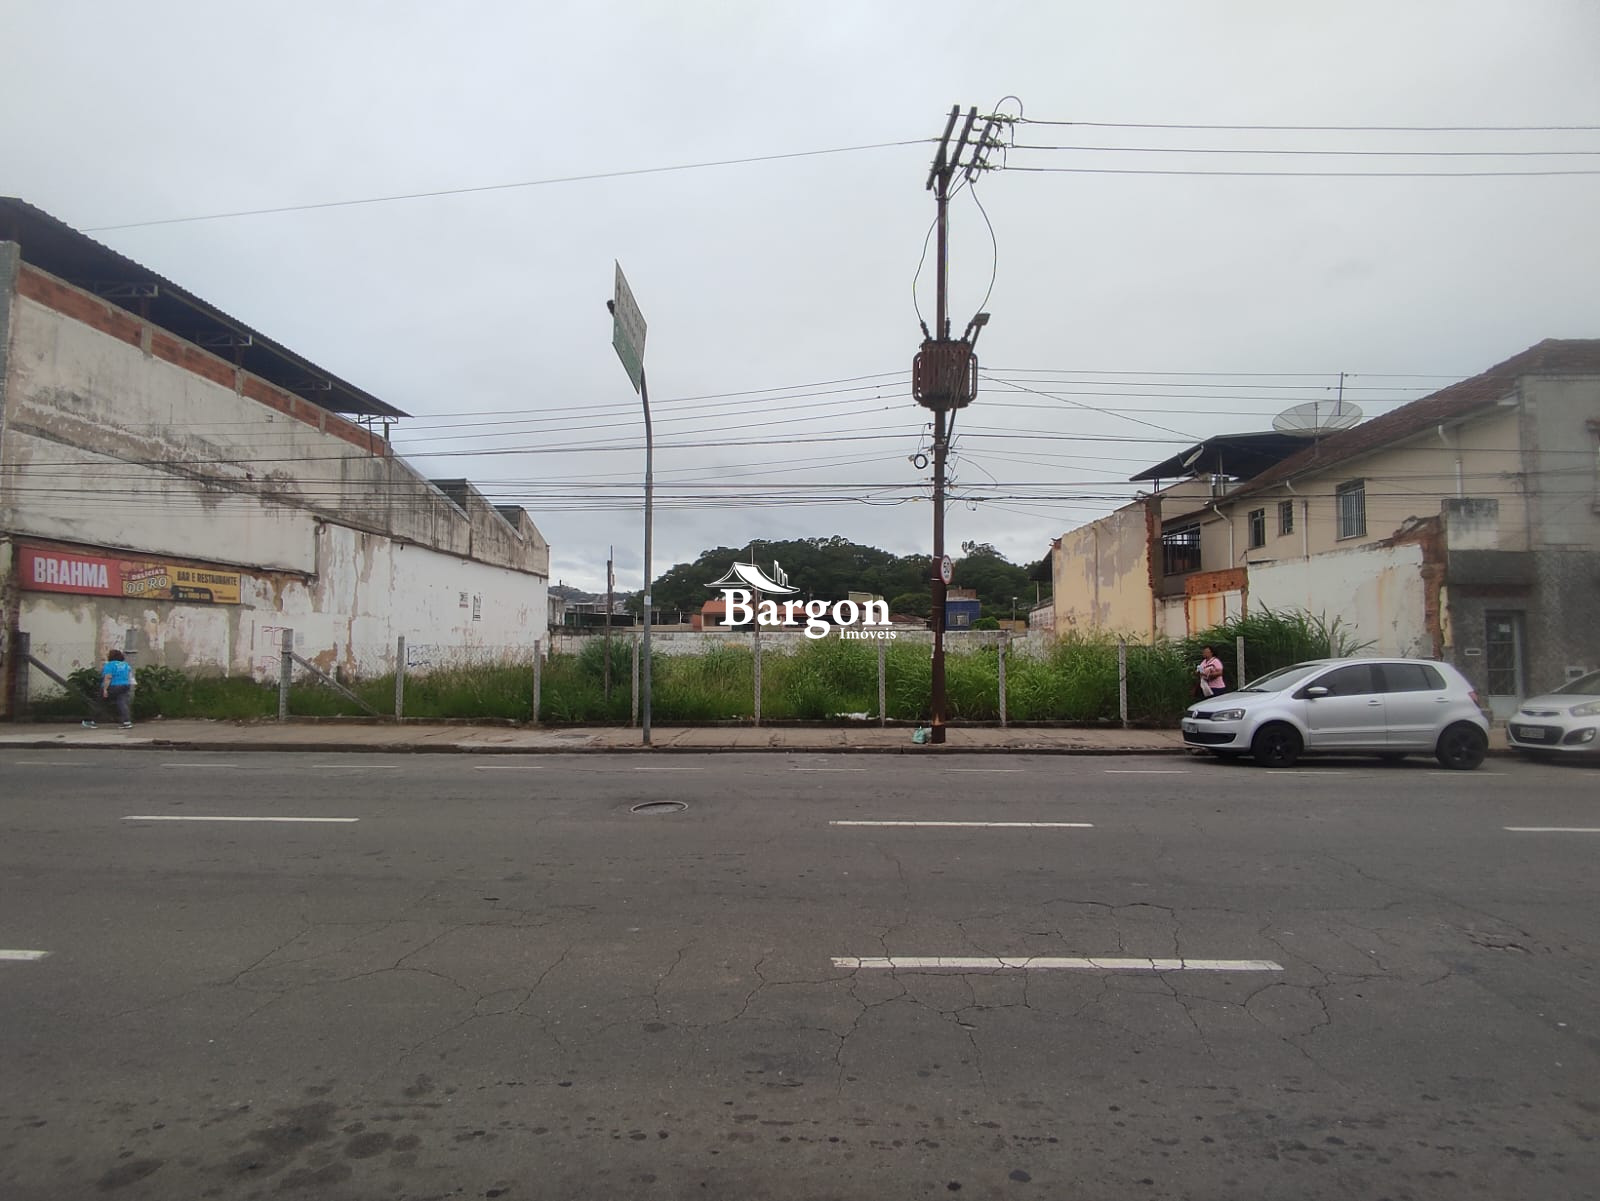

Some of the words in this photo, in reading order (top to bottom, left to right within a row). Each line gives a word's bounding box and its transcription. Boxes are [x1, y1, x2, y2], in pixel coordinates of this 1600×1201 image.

[34, 556, 109, 589] BRAHMA
[177, 571, 190, 581] BAR
[191, 573, 196, 582] E
[197, 573, 238, 586] RESTAURANTE
